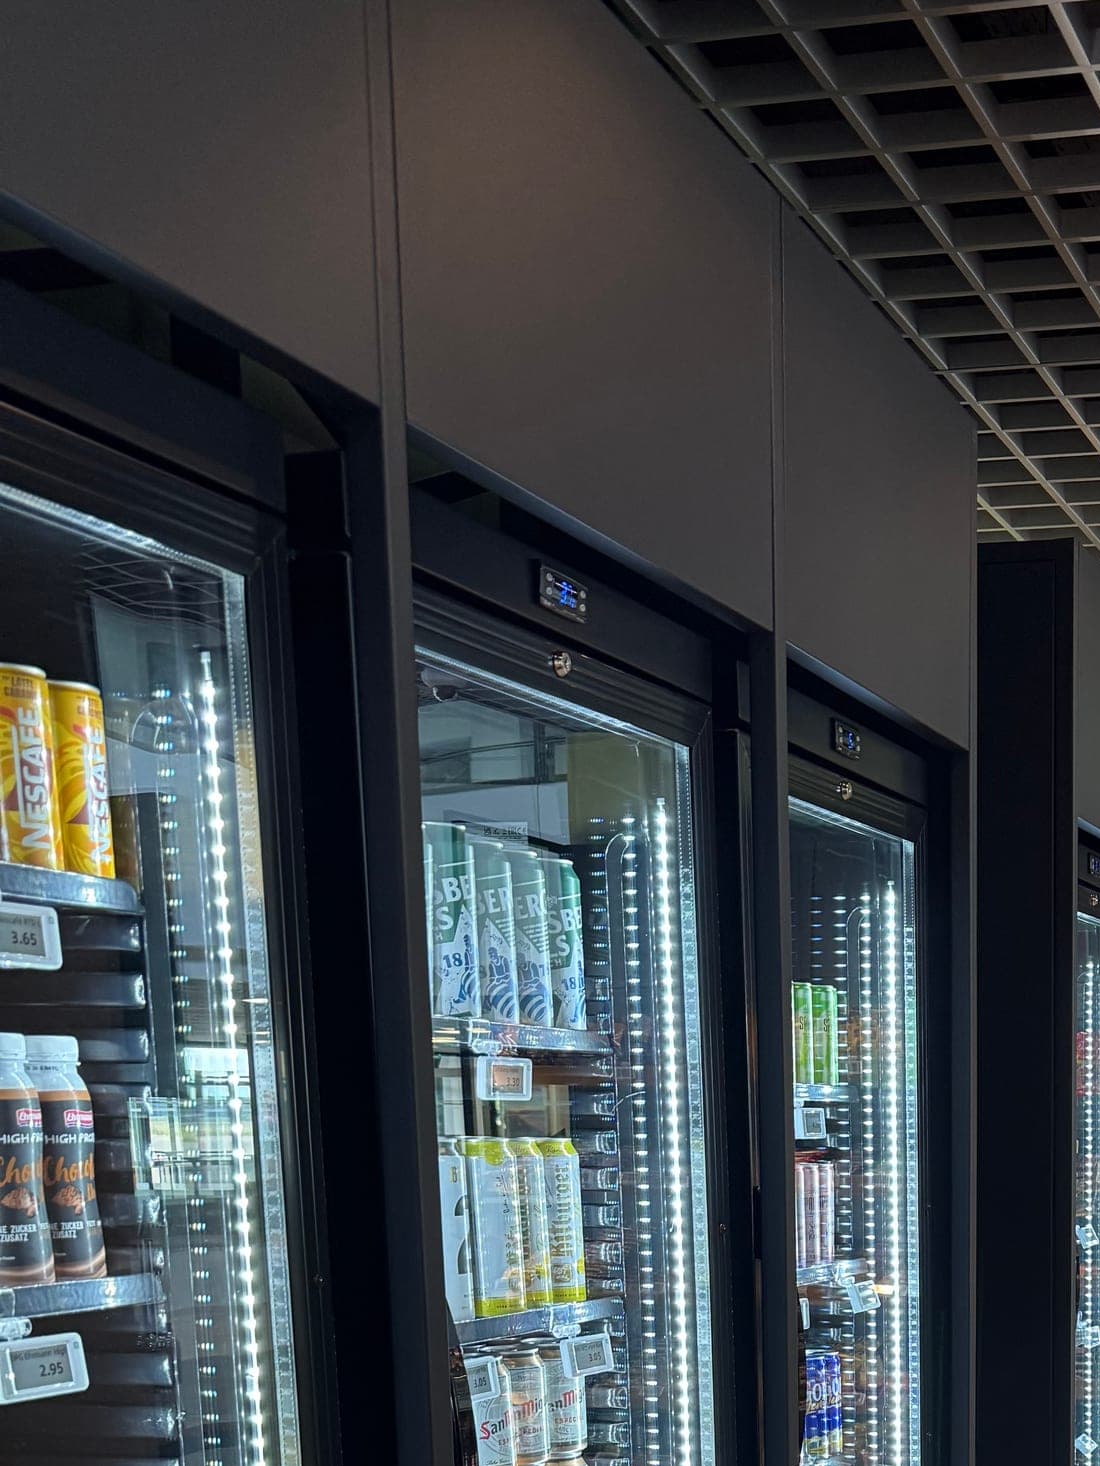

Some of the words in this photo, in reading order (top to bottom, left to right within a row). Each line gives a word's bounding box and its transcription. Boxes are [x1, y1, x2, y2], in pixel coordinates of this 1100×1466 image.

[11, 931, 37, 946] 3.65
[45, 1133, 76, 1145] HIGH
[10, 1224, 37, 1233] ZUCKER
[61, 1220, 84, 1230] ZUCKER
[40, 1361, 64, 1377] 2.95
